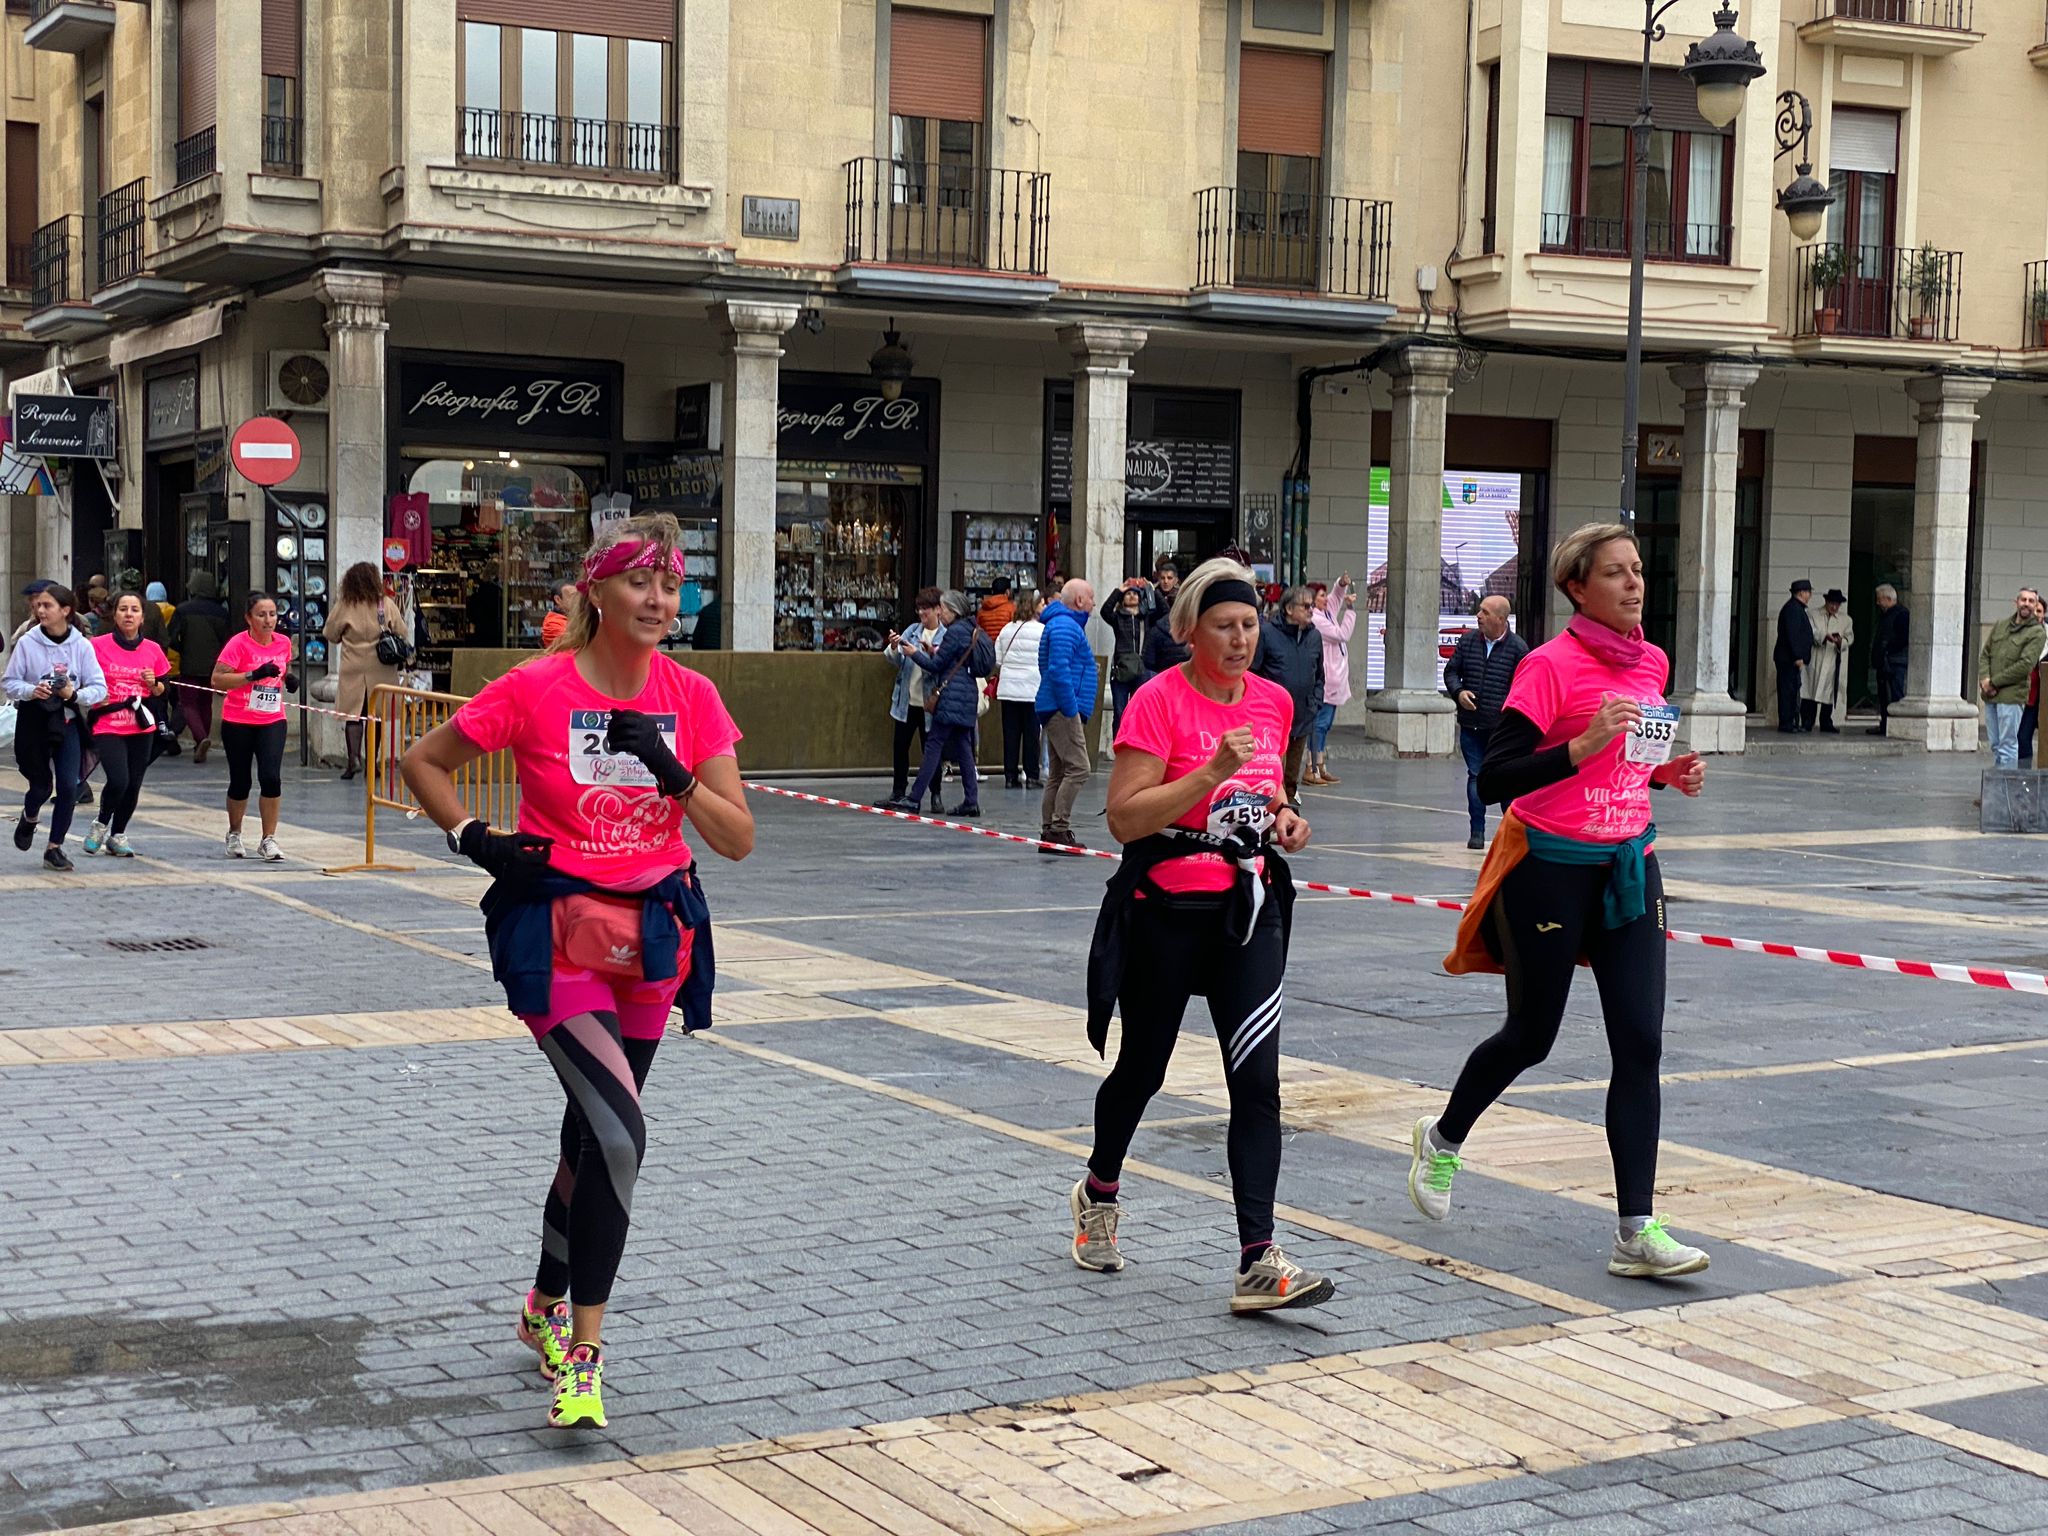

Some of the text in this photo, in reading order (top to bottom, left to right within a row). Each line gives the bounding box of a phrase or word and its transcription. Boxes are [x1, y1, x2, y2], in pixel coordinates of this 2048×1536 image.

[20, 403, 77, 427] Regalos
[21, 428, 83, 447] Souvenir
[1126, 459, 1160, 477] NAURA
[638, 484, 660, 499] DE
[257, 693, 277, 702] 4152
[1635, 721, 1672, 741] 3653
